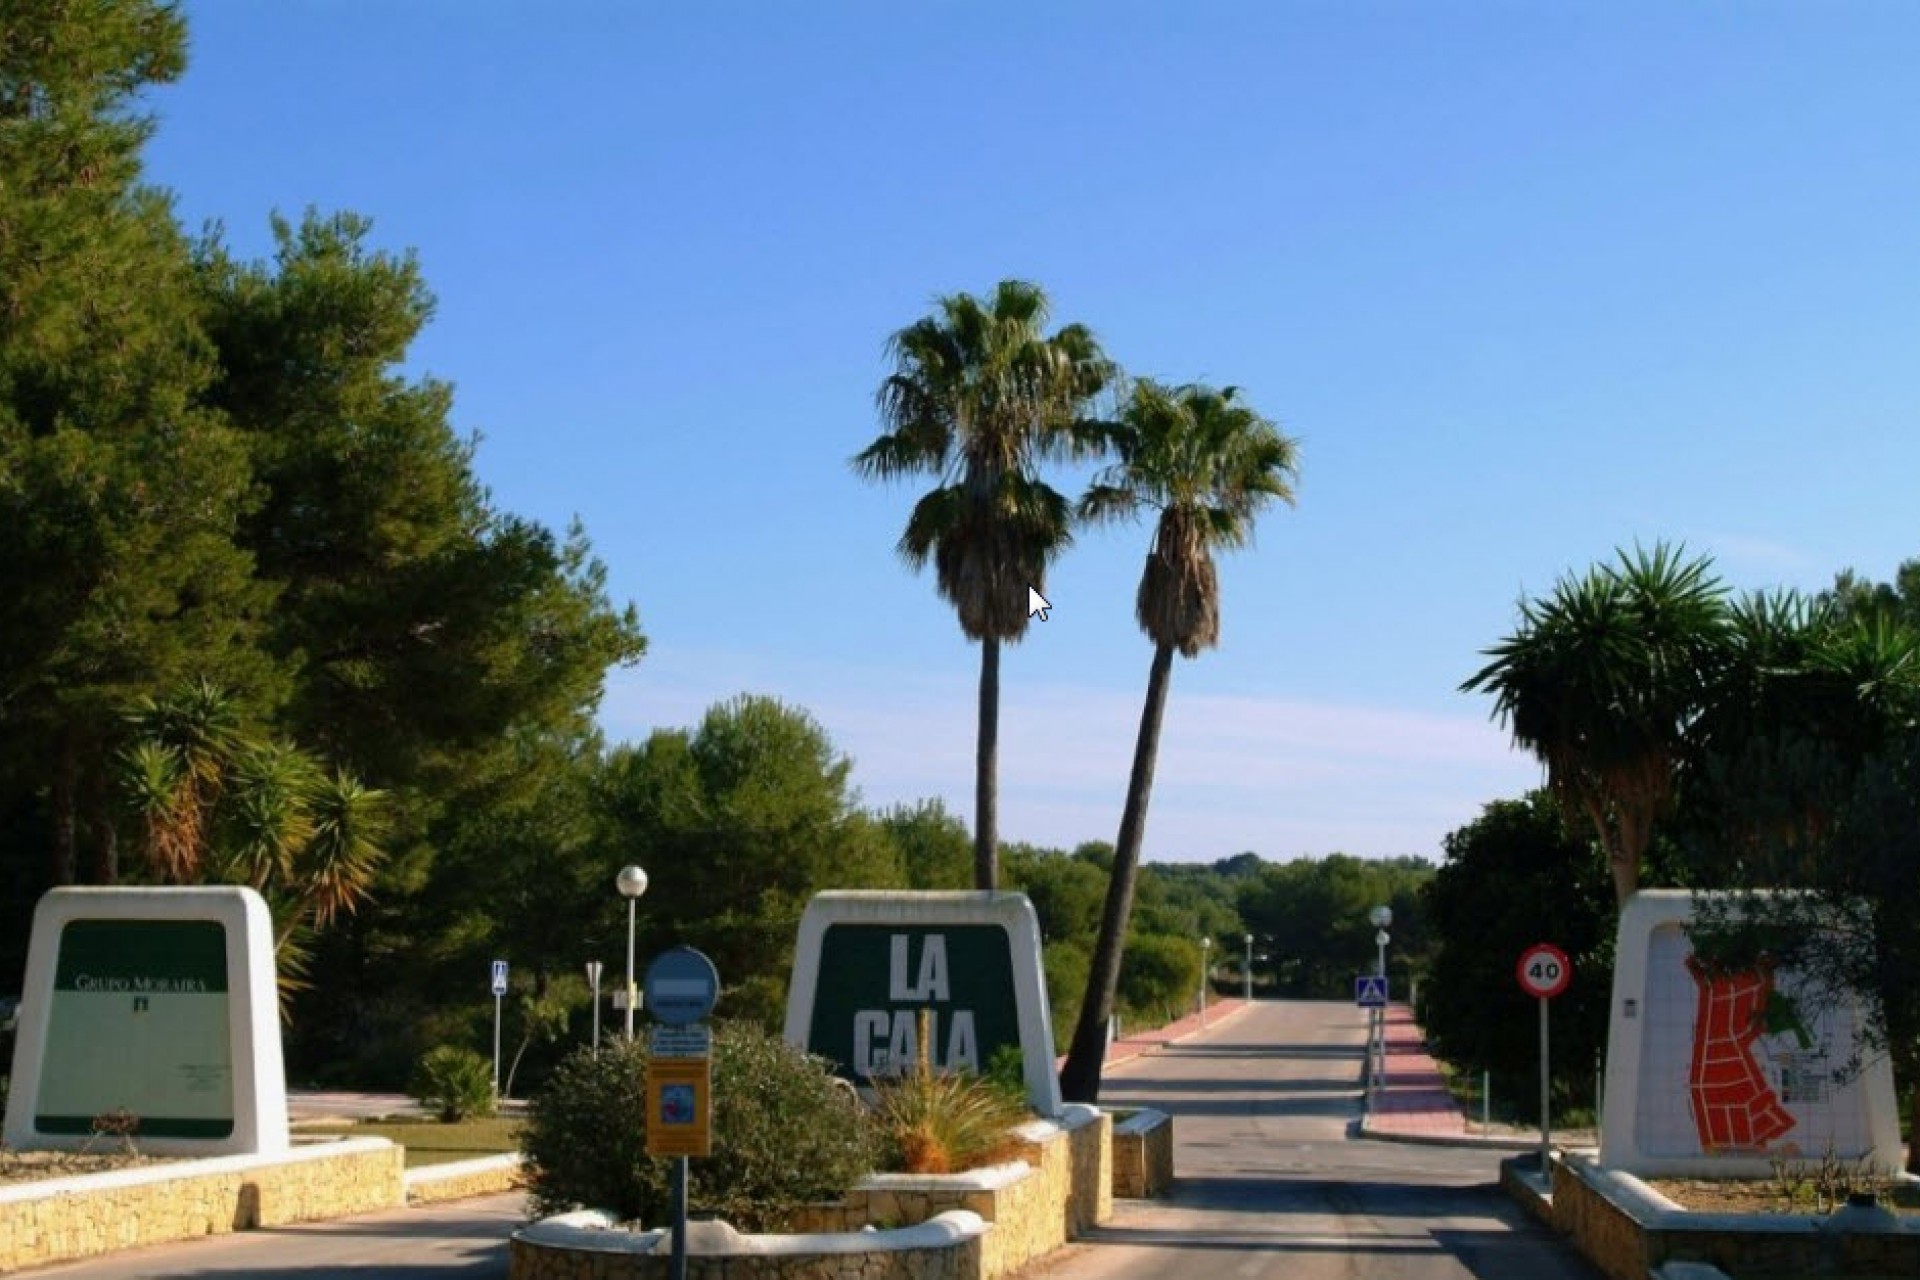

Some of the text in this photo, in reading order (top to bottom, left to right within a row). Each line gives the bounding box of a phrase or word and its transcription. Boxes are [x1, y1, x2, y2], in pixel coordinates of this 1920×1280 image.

[890, 934, 950, 1001] LA
[1529, 962, 1560, 980] 40
[75, 973, 131, 992] GRUPO
